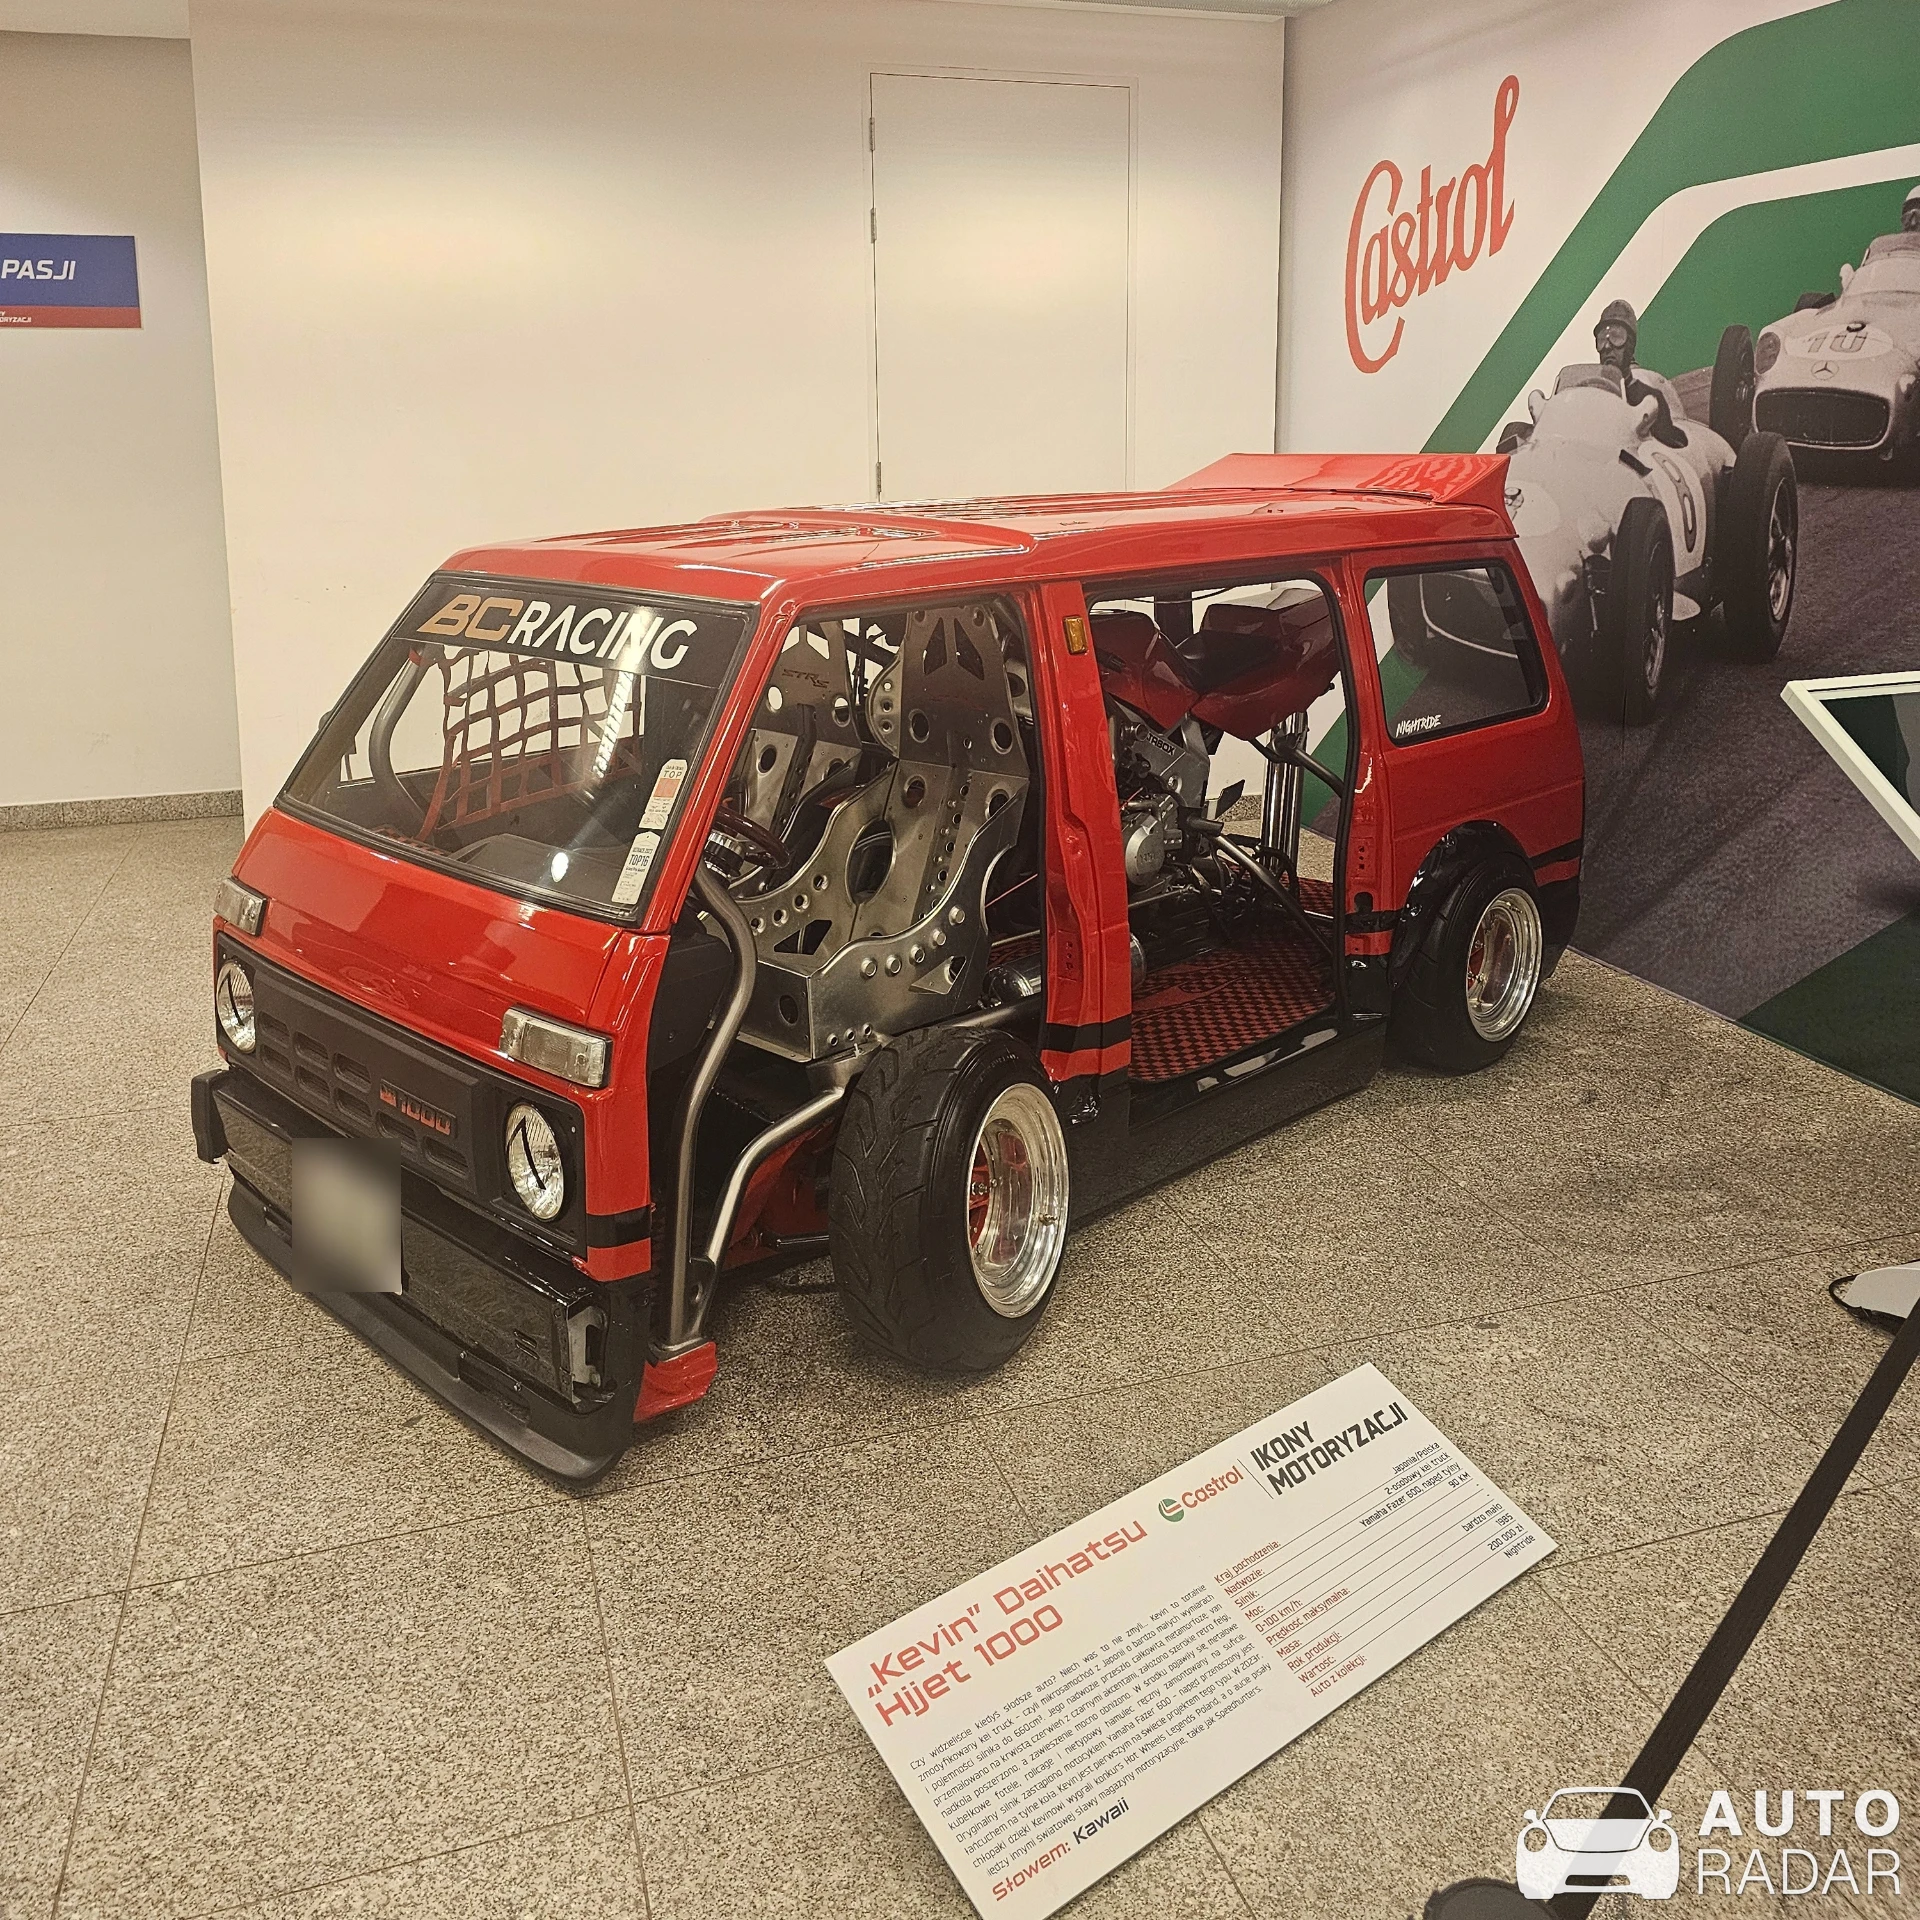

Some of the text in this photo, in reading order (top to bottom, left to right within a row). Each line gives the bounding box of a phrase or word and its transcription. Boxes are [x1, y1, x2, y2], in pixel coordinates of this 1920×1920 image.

[1345, 75, 1520, 374] Castrol
[1, 259, 76, 280] PASJI
[1395, 714, 1442, 738] NIGHTRIDE
[663, 770, 682, 779] TOP
[1249, 1420, 1315, 1472] IKONY
[1266, 1401, 1409, 1496] MOTORYZACJI
[1391, 1441, 1440, 1475] Japonia/Polska
[1418, 1461, 1433, 1473] kei
[1429, 1451, 1451, 1466] truck
[1181, 1464, 1244, 1509] Castrol
[1358, 1507, 1389, 1528] Yamaha
[1385, 1494, 1407, 1512] Fazer
[1440, 1461, 1461, 1476] tylny
[1447, 1470, 1472, 1489] 90 KM
[1460, 1502, 1503, 1532] bardzo mało
[1486, 1537, 1504, 1552] 200
[1514, 1522, 1525, 1533] zł
[992, 1519, 1148, 1616] Daihatsu
[1213, 1540, 1282, 1584] Kraj pochodzenia:
[1502, 1534, 1536, 1559] Nightride
[1223, 1568, 1266, 1596] Nadwozie:
[1233, 1590, 1260, 1608] Silnik:
[1244, 1605, 1266, 1621] Moc:
[1265, 1587, 1351, 1646] Prędkość maksymalna:
[1276, 1599, 1304, 1618] km/h:
[874, 1604, 1063, 1727] Hijet 1000
[1275, 1639, 1303, 1659] Masa:
[1286, 1630, 1343, 1672] Rok produkcji:
[1297, 1654, 1337, 1683] Wartość:
[909, 1756, 926, 1771] Czy
[928, 1728, 973, 1758] widzieliście
[1002, 1691, 1033, 1713] słodsze
[1034, 1674, 1057, 1693] auto?
[1058, 1662, 1081, 1678] Niech
[1081, 1650, 1099, 1663] was
[1099, 1643, 1111, 1652] to
[1111, 1635, 1124, 1646] nie
[1148, 1607, 1170, 1622] Kevin
[1169, 1601, 1180, 1609] to
[1180, 1584, 1207, 1603] totalnie
[931, 1757, 975, 1792] pojemności
[975, 1742, 1001, 1762] silnika
[1001, 1735, 1014, 1746] do
[1047, 1702, 1066, 1718] Jego
[1065, 1680, 1100, 1705] nadwozie
[1099, 1660, 1132, 1685] przeszło
[1208, 1603, 1223, 1614] van
[1309, 1653, 1368, 1698] Auto kolekcji:
[917, 1740, 978, 1782] zmodyfikowany
[977, 1731, 992, 1744] kei
[991, 1718, 1015, 1735] truck
[1021, 1701, 1040, 1717] czyli
[1101, 1647, 1126, 1668] Japonii
[1130, 1630, 1157, 1648] bardzo
[932, 1766, 990, 1808] przemalowano
[989, 1759, 1001, 1771] na
[999, 1740, 1033, 1763] krwistą
[1070, 1692, 1104, 1719] czarnymi
[1102, 1670, 1140, 1698] akcentami,
[1167, 1634, 1197, 1656] szerokie
[1195, 1623, 1215, 1638] retro
[940, 1794, 973, 1819] nadkola
[973, 1764, 1021, 1799] poszerzono,
[1028, 1729, 1074, 1762] zawieszenie
[1074, 1712, 1099, 1732] mocno
[1142, 1668, 1168, 1688] środku
[1206, 1623, 1239, 1646] metalowe
[999, 1796, 1021, 1815] silnik
[1063, 1740, 1108, 1773] motocyklem
[1105, 1721, 1136, 1743] Yamaha
[1133, 1707, 1155, 1725] Fazer
[1199, 1651, 1241, 1683] przenoszony
[1239, 1642, 1255, 1657] jest
[947, 1799, 992, 1831] kubełkowe
[994, 1780, 1022, 1800] fotele,
[1064, 1726, 1103, 1755] nietypowy
[1103, 1705, 1136, 1728] hamulec
[1162, 1656, 1209, 1690] zamontowany
[1210, 1649, 1221, 1659] na
[963, 1823, 1008, 1856] łańcuchem
[1006, 1815, 1019, 1827] na
[1017, 1801, 1040, 1819] tylne
[1056, 1775, 1079, 1793] Kevin
[1076, 1765, 1095, 1782] jest
[1092, 1740, 1133, 1771] pierwszym
[1130, 1733, 1143, 1744] na
[1165, 1694, 1201, 1722] projektem
[1198, 1683, 1217, 1698] tego
[972, 1839, 1007, 1868] chłopaki
[1007, 1823, 1032, 1845] dzięki
[1030, 1800, 1066, 1828] Kevinowi
[1065, 1782, 1094, 1804] wygrali
[1092, 1761, 1125, 1786] konkurs
[1123, 1751, 1140, 1765] Hot
[1137, 1733, 1167, 1755] Wheels
[1164, 1713, 1197, 1737] Legends
[1194, 1696, 1222, 1717] Poland,
[1232, 1676, 1252, 1692] aucie
[985, 1857, 1011, 1878] iędzy
[1009, 1837, 1037, 1861] innymi
[1035, 1810, 1077, 1843] światowej
[1074, 1796, 1099, 1817] sławy
[1097, 1771, 1136, 1801] magazyny
[1185, 1724, 1206, 1739] takie
[1203, 1716, 1217, 1730] jak
[991, 1796, 1130, 1902] Słowem: Kawaii
